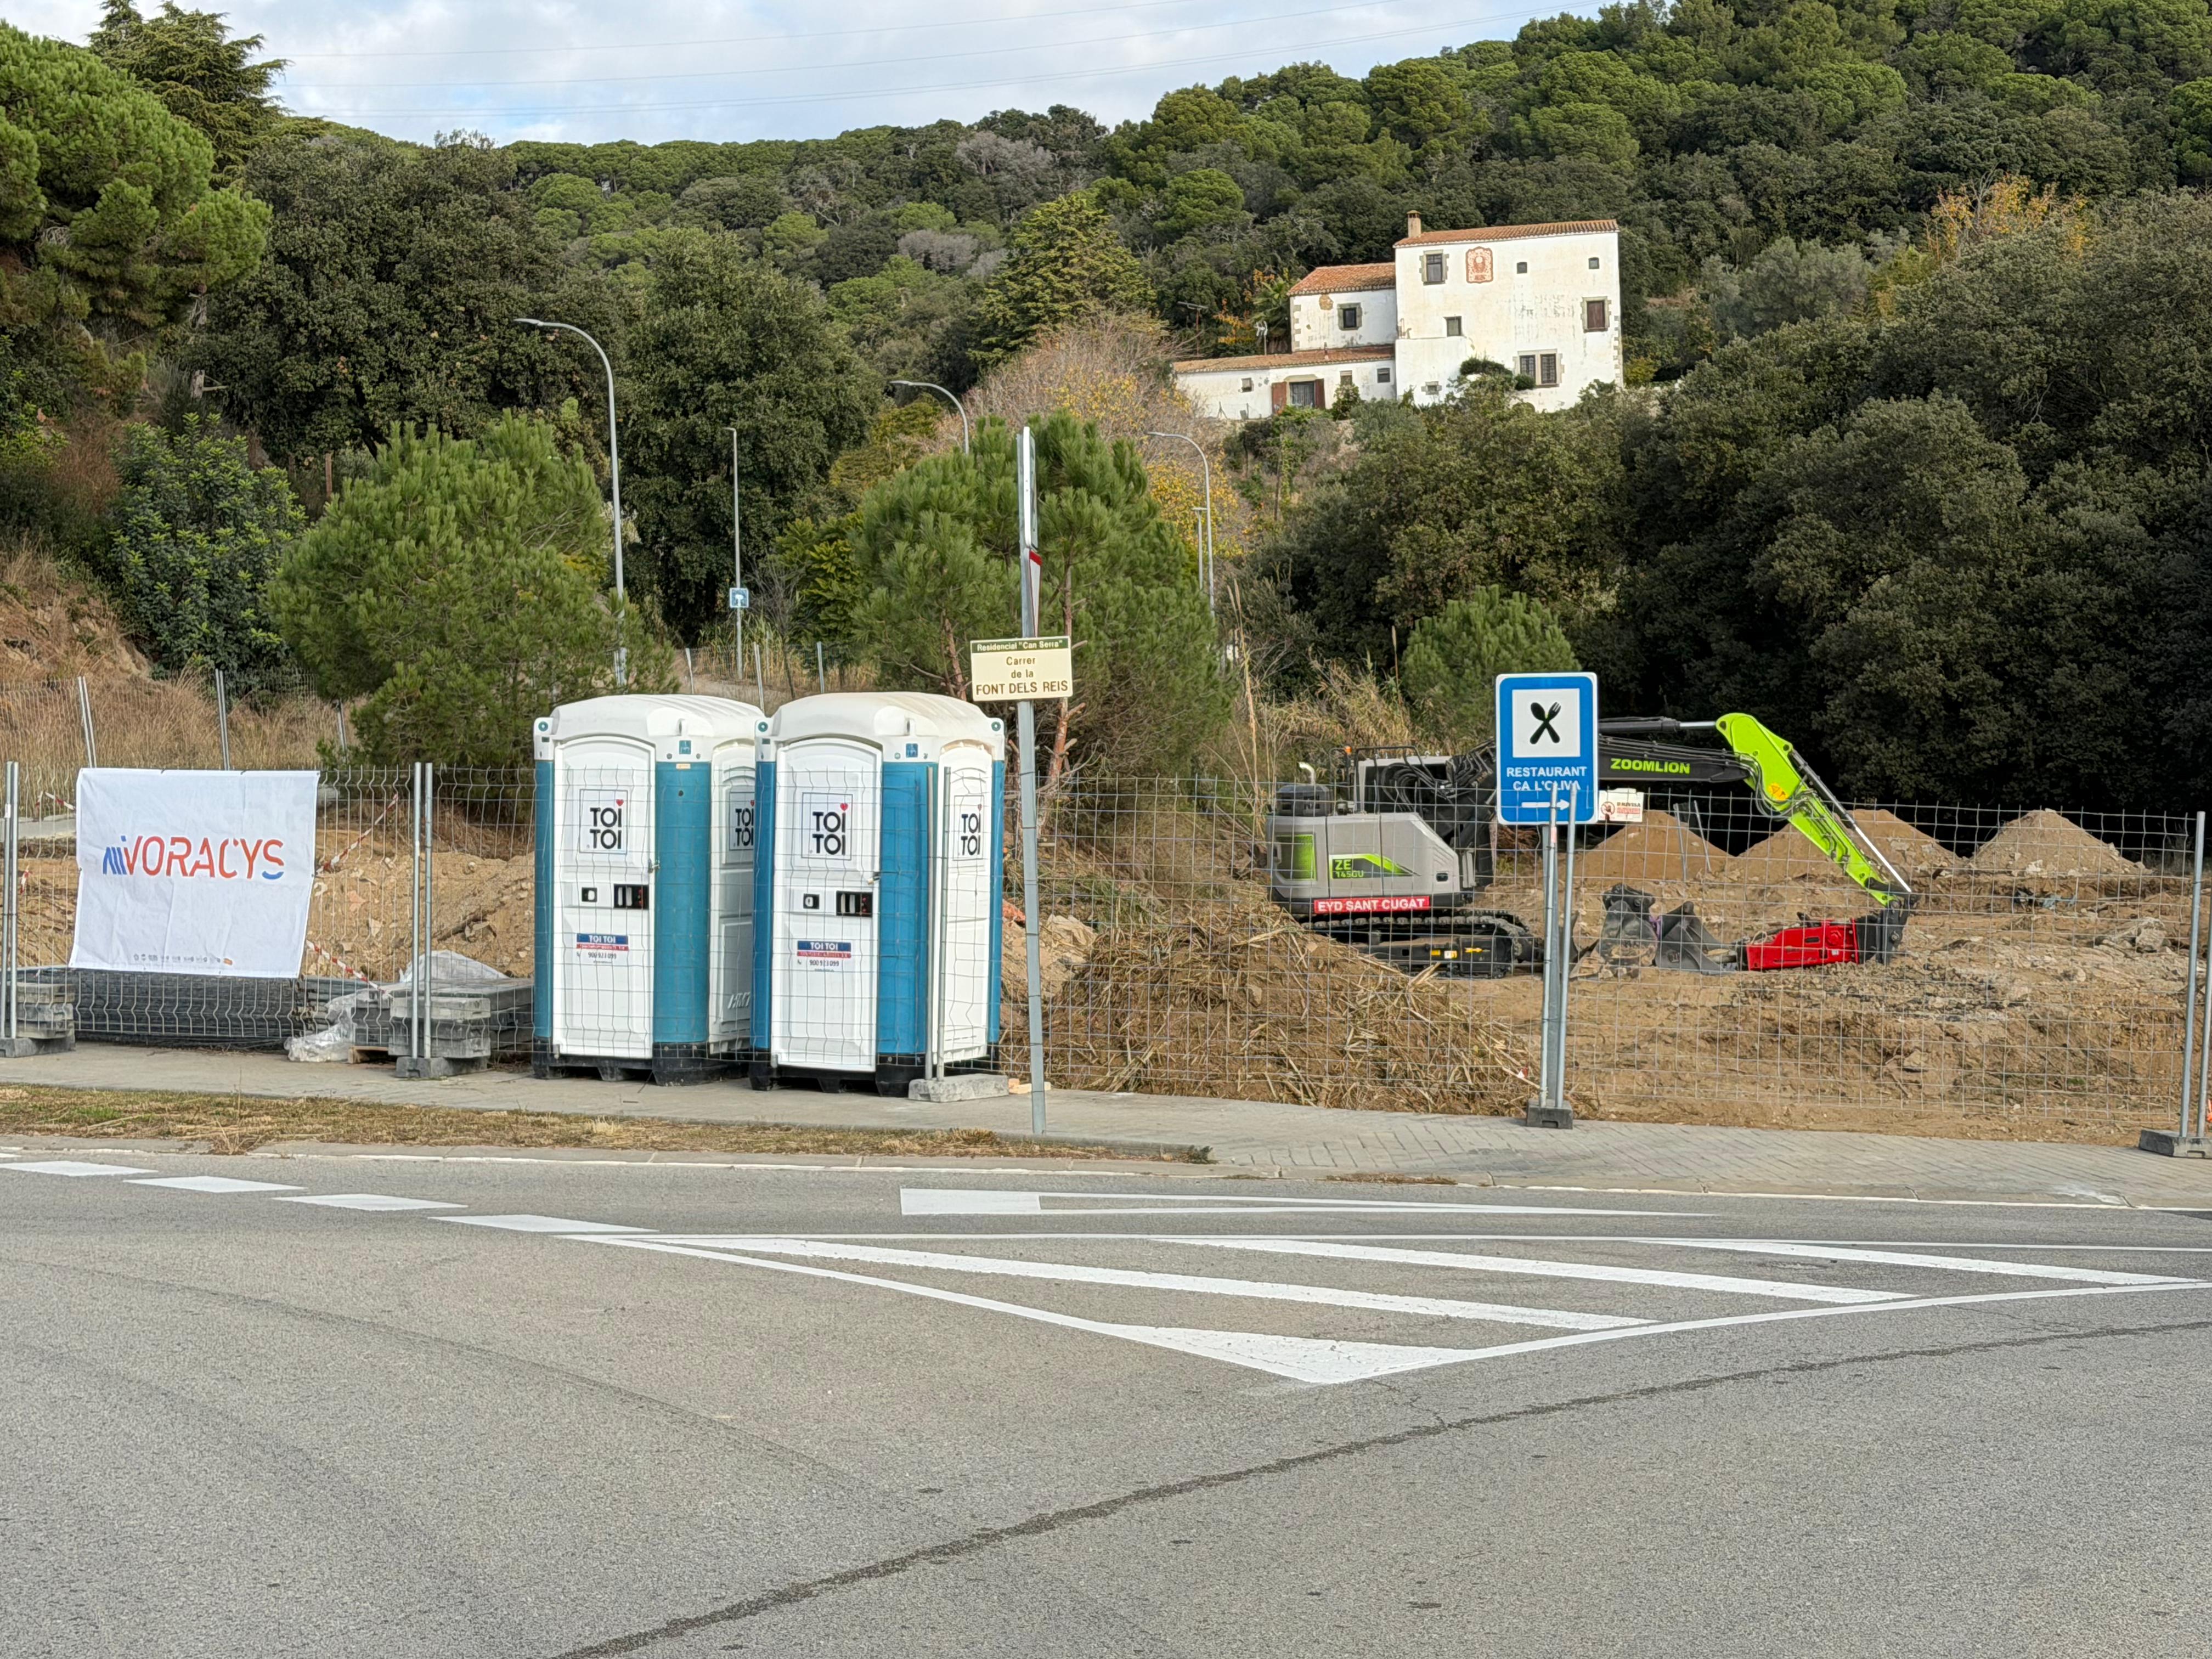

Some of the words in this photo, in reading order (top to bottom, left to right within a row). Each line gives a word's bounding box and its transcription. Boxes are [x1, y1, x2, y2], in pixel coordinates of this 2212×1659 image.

[977, 642, 1017, 652] Residencial
[1006, 656, 1036, 665] Carrer
[1011, 670, 1022, 678] de
[1025, 669, 1034, 678] la
[976, 684, 1005, 695] FONT
[1009, 681, 1037, 693] DELS
[1043, 680, 1068, 692] REIS
[1506, 766, 1587, 777] RESTAURANT
[1610, 758, 1690, 774] ZOOMLION
[1513, 781, 1530, 791] CA
[1534, 780, 1581, 791] L'OIVA
[589, 829, 622, 849] TOI
[735, 828, 754, 847] TOI
[812, 834, 846, 856] TOI
[961, 835, 981, 856] TOI
[1335, 860, 1351, 871] ZE
[1318, 901, 1342, 912] EYD
[1346, 900, 1379, 911] SANT
[1381, 898, 1425, 910] CUGAT
[810, 942, 823, 950] TOI
[825, 943, 838, 951] TOI
